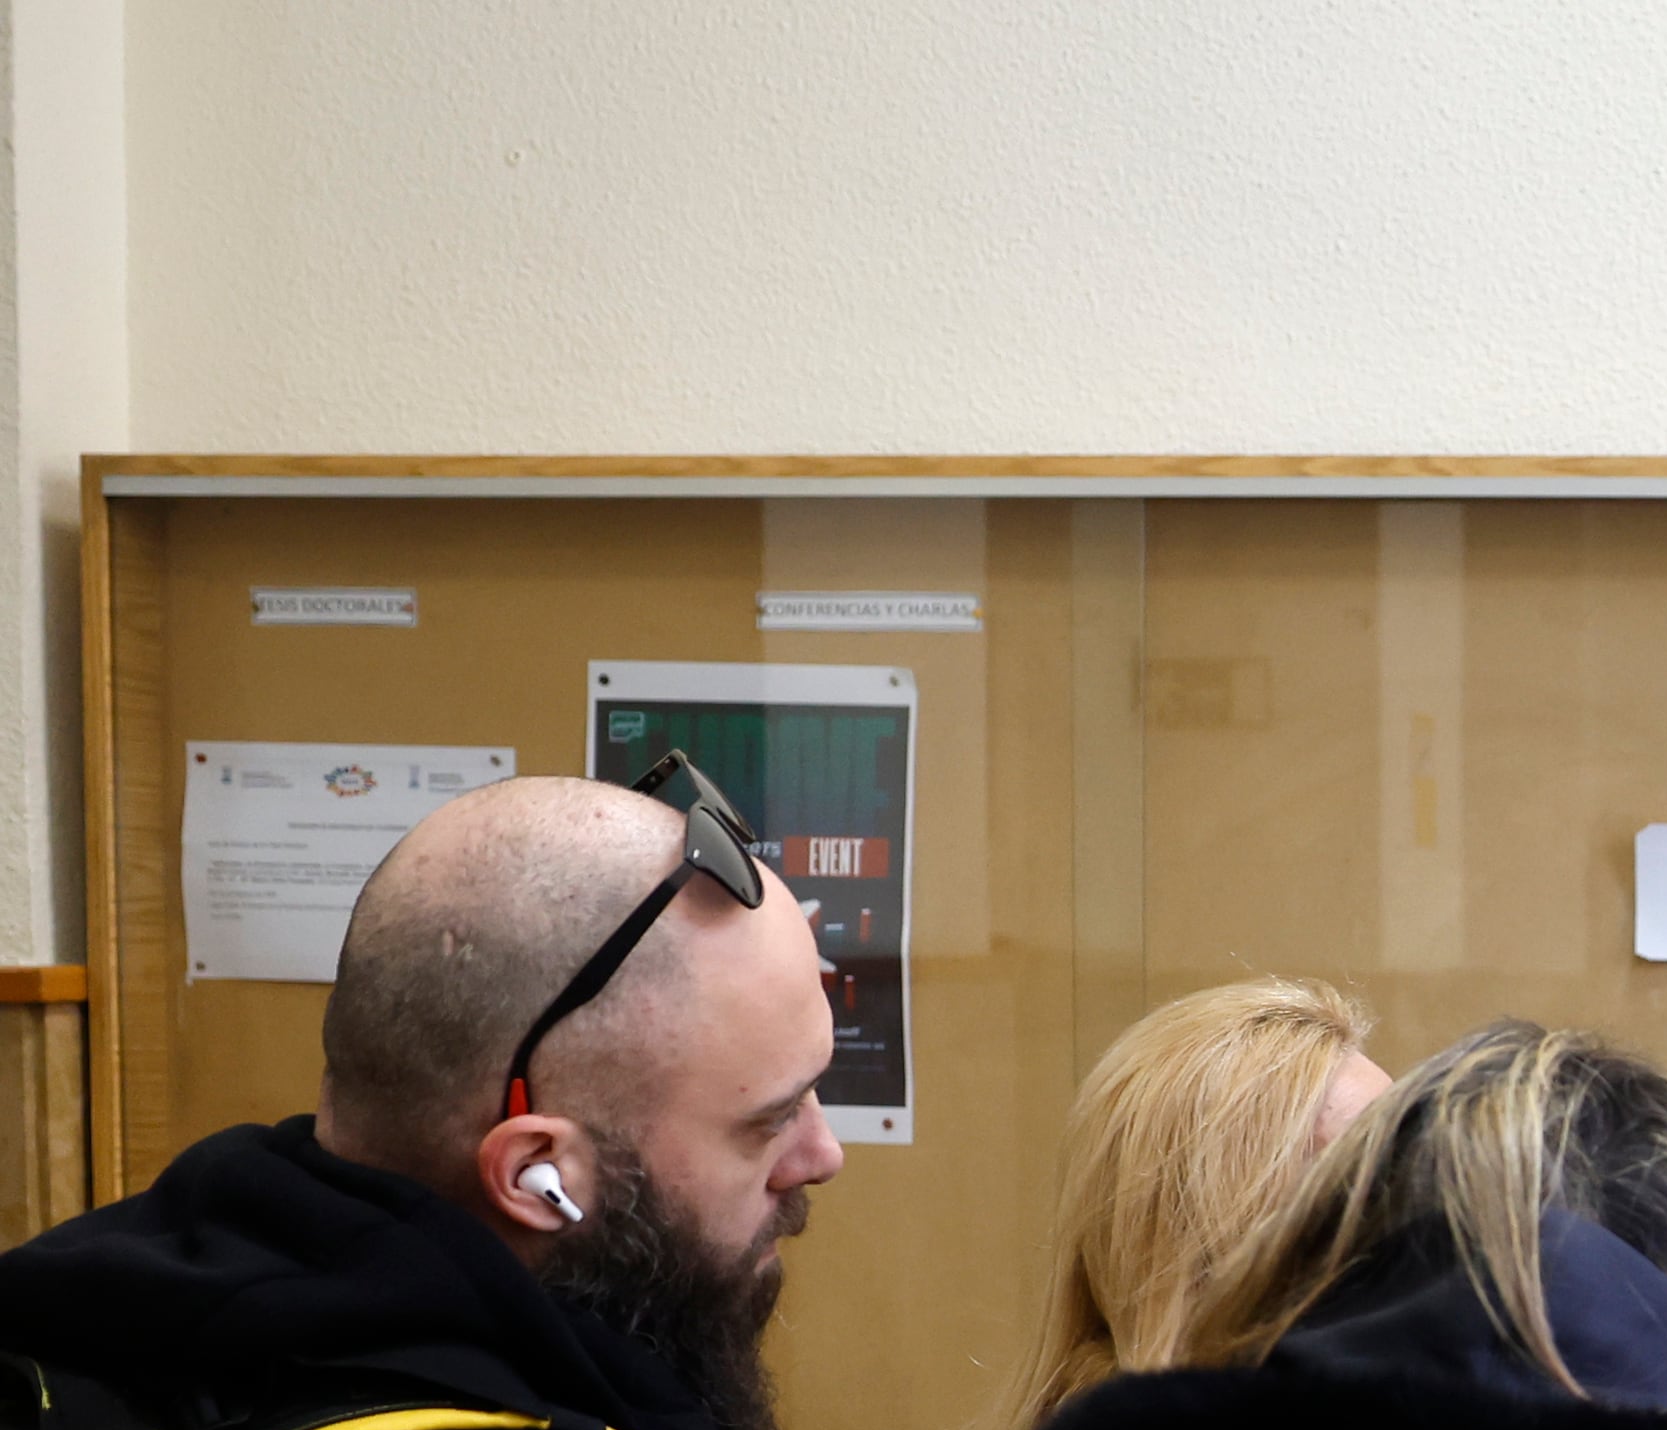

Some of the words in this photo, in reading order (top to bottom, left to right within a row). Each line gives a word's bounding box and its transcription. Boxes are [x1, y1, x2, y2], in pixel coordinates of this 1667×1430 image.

[762, 602, 881, 616] CONFERENCIAS
[885, 603, 894, 616] Y
[897, 603, 969, 618] CHARLAS
[807, 836, 864, 877] EVENT
